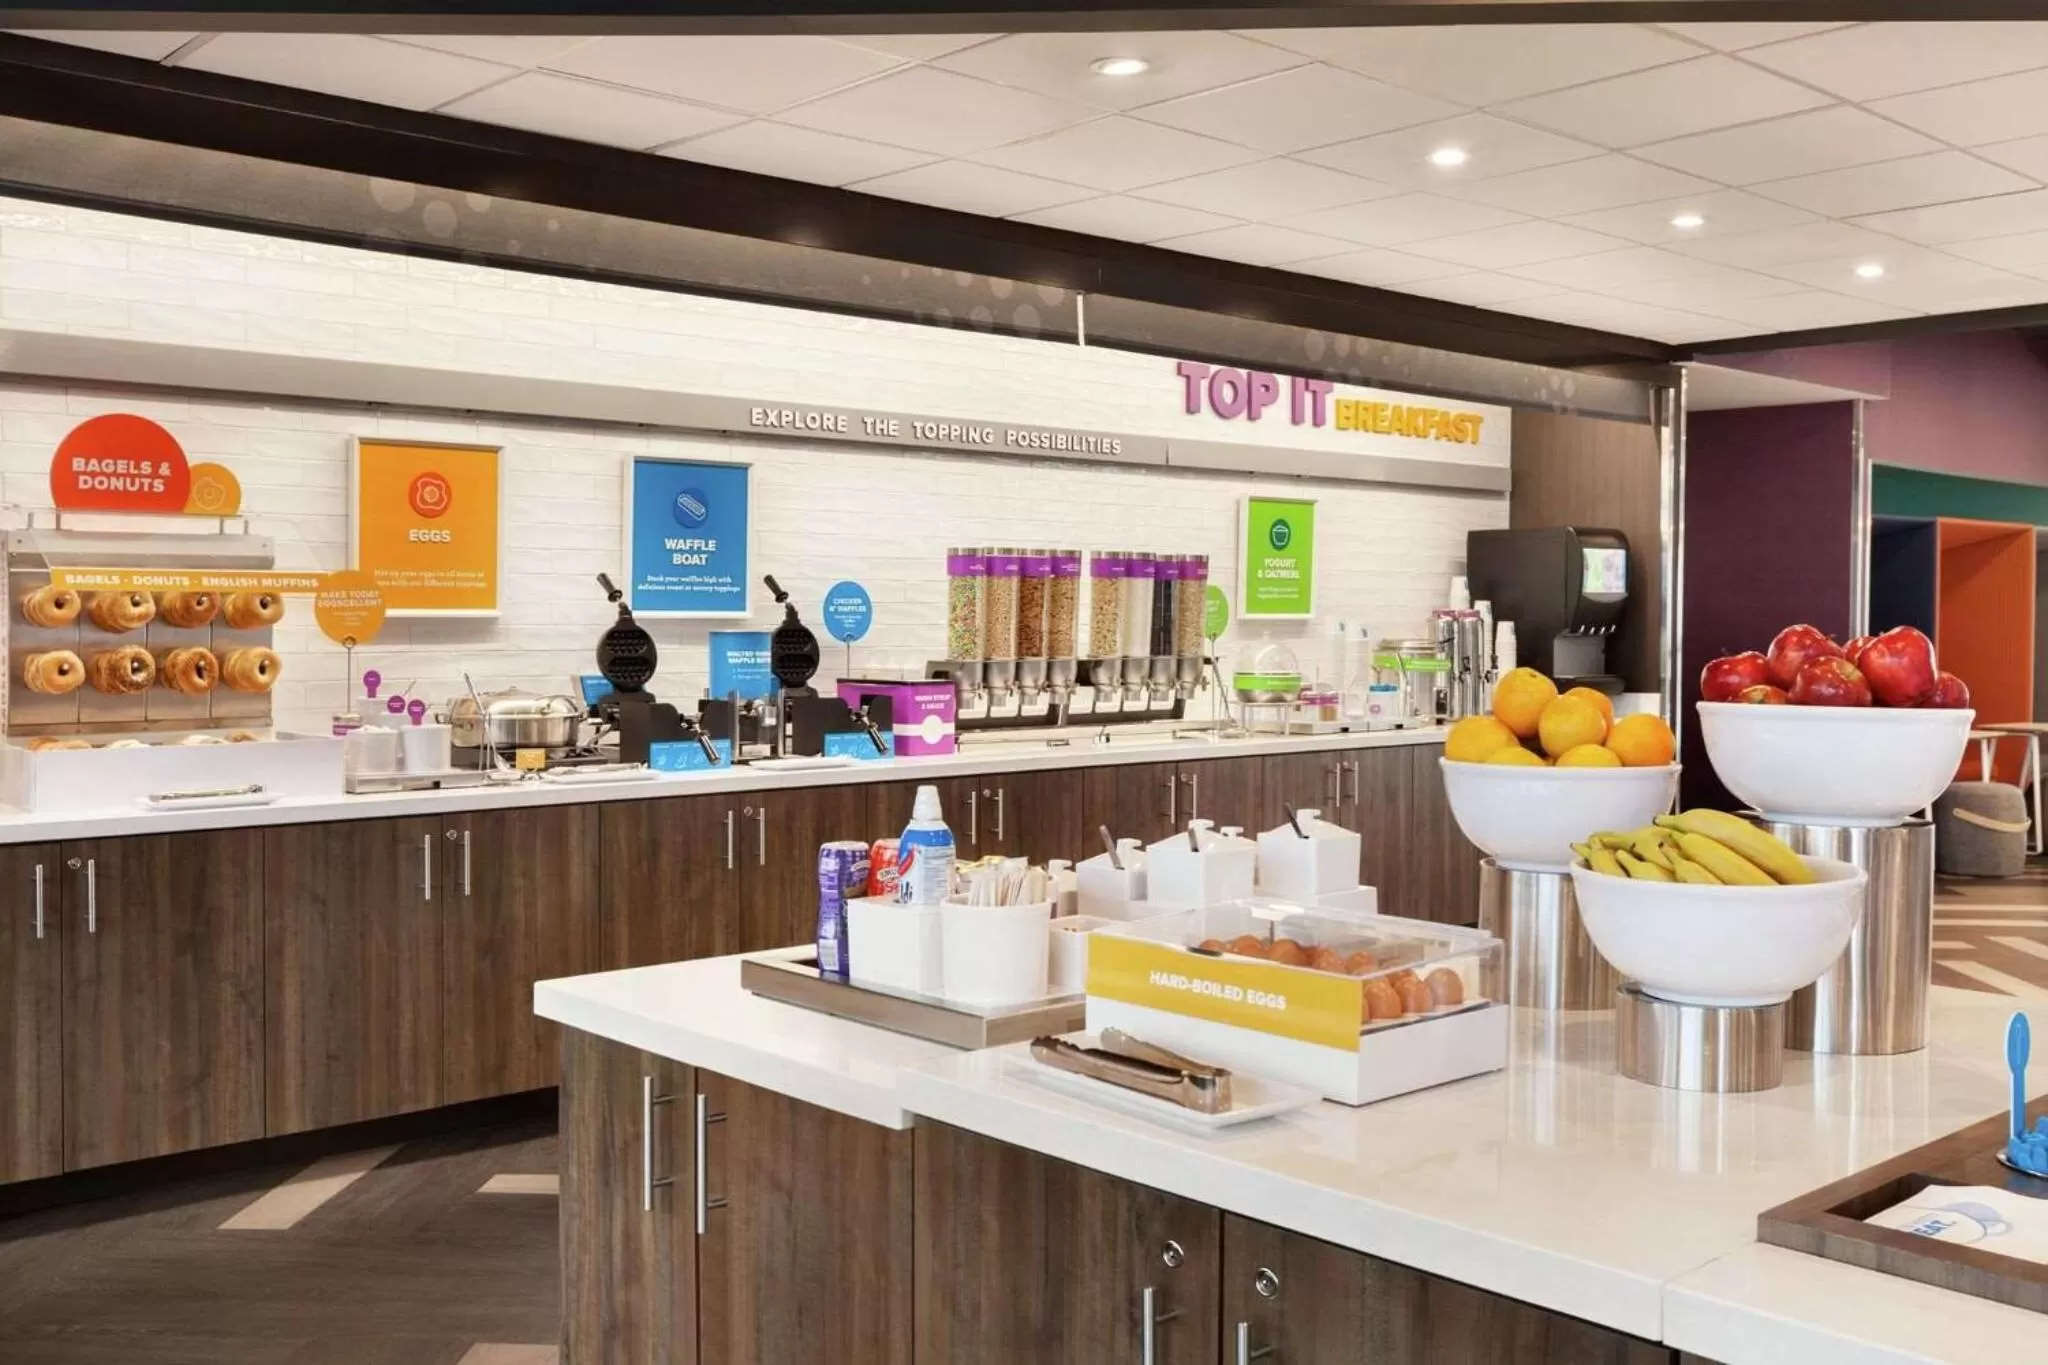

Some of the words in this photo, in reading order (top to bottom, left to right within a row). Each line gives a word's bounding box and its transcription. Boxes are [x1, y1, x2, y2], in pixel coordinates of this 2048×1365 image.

[1176, 360, 1280, 421] TOP
[1291, 375, 1333, 427] IT
[1334, 398, 1484, 445] BREAKFAST
[751, 407, 848, 432] EXPLORE
[862, 416, 900, 437] THE
[912, 421, 994, 444] TOPPING
[1005, 429, 1122, 455] POSSIBILITIES
[71, 457, 152, 476] BAGELS
[158, 462, 173, 477] &
[78, 475, 165, 493] DONUTS
[409, 528, 452, 543] EGGS
[664, 537, 717, 551] WAFFLE
[672, 553, 708, 566] BOAT
[1264, 558, 1297, 568] YOGURT
[64, 573, 121, 586] BAGELS
[132, 575, 190, 587] DONUTS
[201, 576, 258, 588] ENGLISH
[262, 577, 319, 589] MUFFINS
[718, 575, 733, 583] with
[1264, 569, 1301, 579] OATMEAL
[350, 590, 380, 598] TODAY
[1149, 969, 1244, 1002] HARD-BOILED
[1246, 989, 1287, 1011] EGGS
